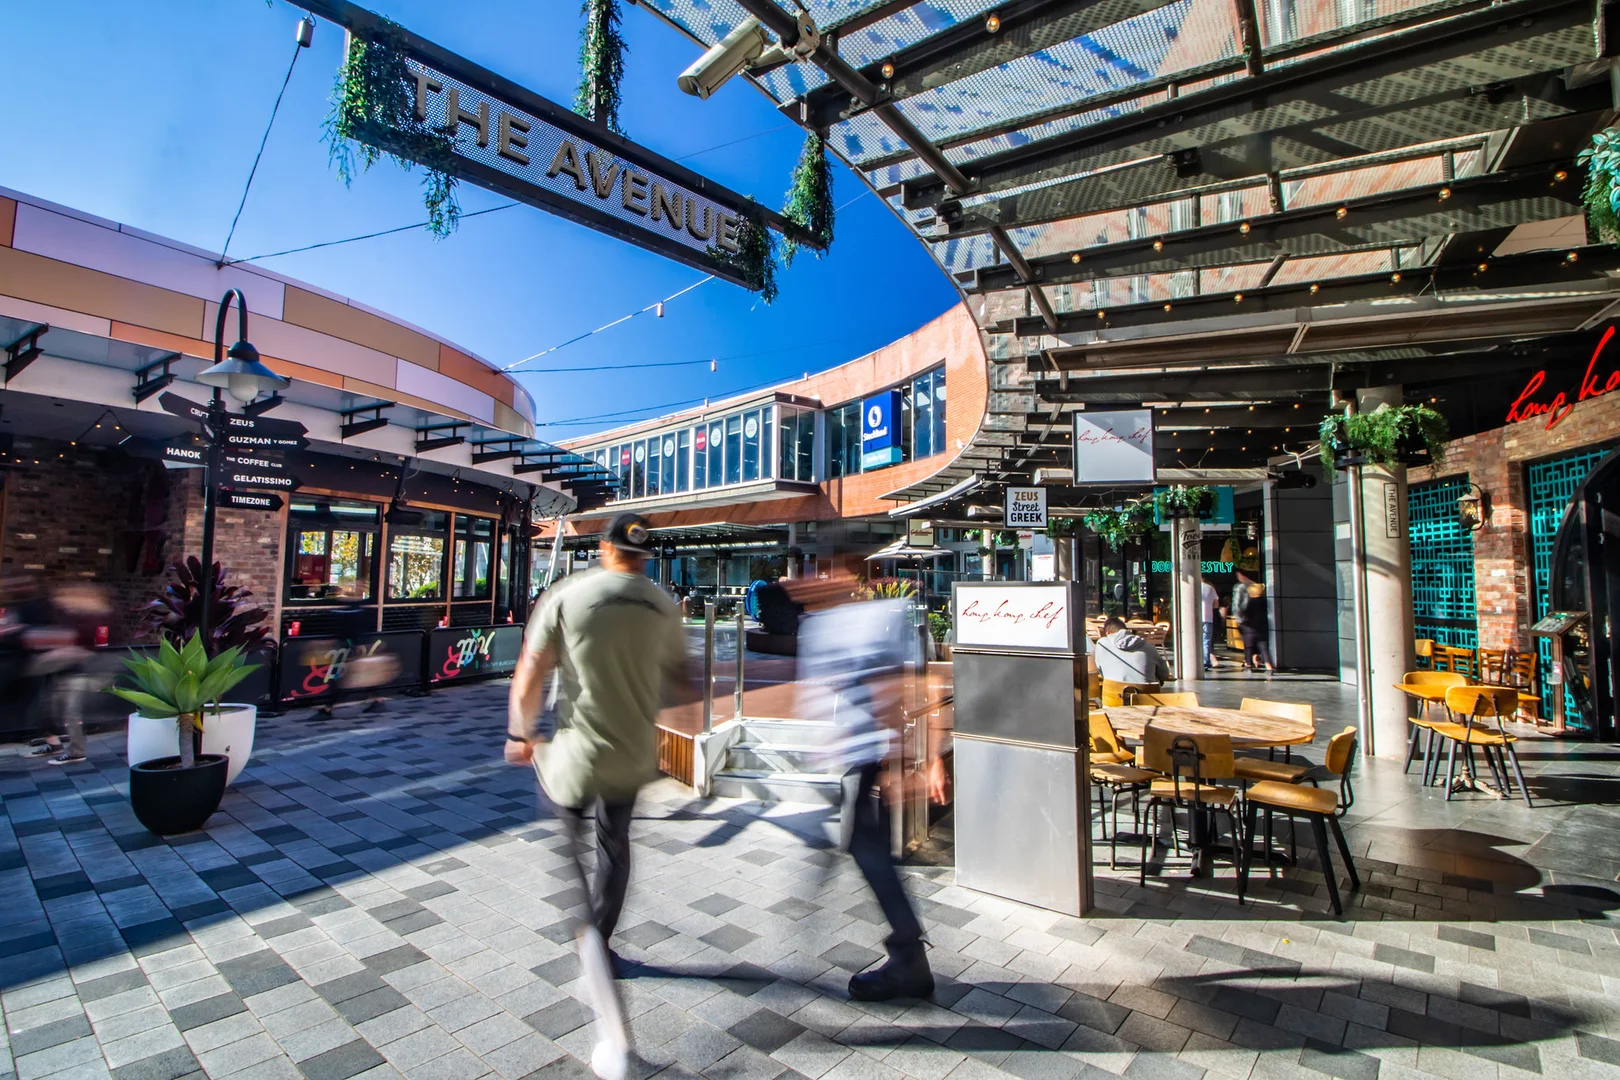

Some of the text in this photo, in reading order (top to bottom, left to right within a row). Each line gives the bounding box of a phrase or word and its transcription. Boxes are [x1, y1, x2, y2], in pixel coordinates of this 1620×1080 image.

[408, 68, 740, 253] THE AVENUE
[230, 418, 255, 428] ZEUS
[228, 436, 271, 445] GUZMAN
[1128, 427, 1152, 444] chef
[166, 447, 201, 459] HANOK
[237, 457, 270, 468] COFFEE
[233, 474, 292, 486] GELATISSIMO
[231, 495, 271, 506] TIMEZONE
[1014, 491, 1039, 501] ZEUS
[1012, 502, 1041, 512] Street
[1388, 488, 1398, 532] THE AVENUE
[1010, 513, 1043, 522] GREEK
[1200, 561, 1235, 574] ESTLY
[962, 599, 1064, 629] hong kong chef
